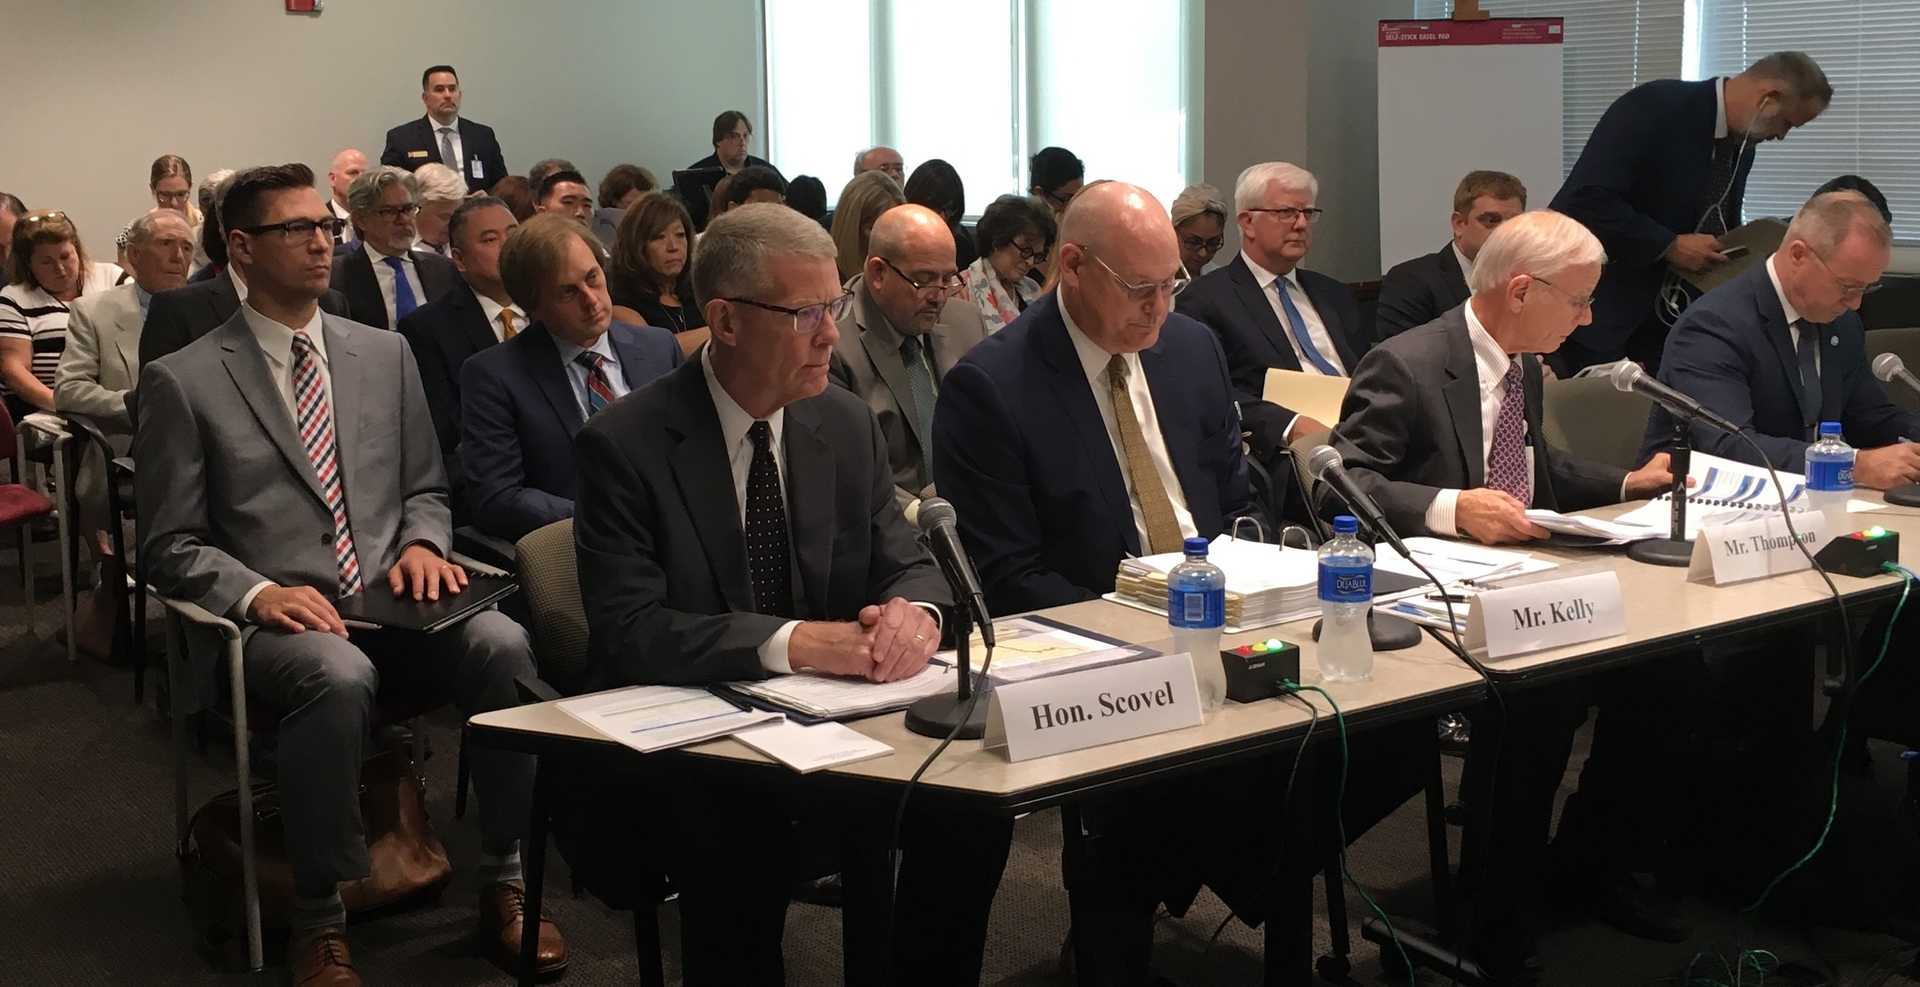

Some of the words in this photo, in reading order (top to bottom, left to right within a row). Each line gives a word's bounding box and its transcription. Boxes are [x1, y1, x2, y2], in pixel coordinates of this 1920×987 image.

[1723, 539, 1749, 557] Mr.
[1749, 531, 1816, 552] Thompon
[1512, 606, 1546, 631] Mr.
[1549, 598, 1595, 624] Kelly
[1030, 702, 1093, 731] Hon.
[1097, 680, 1176, 718] Scovel
